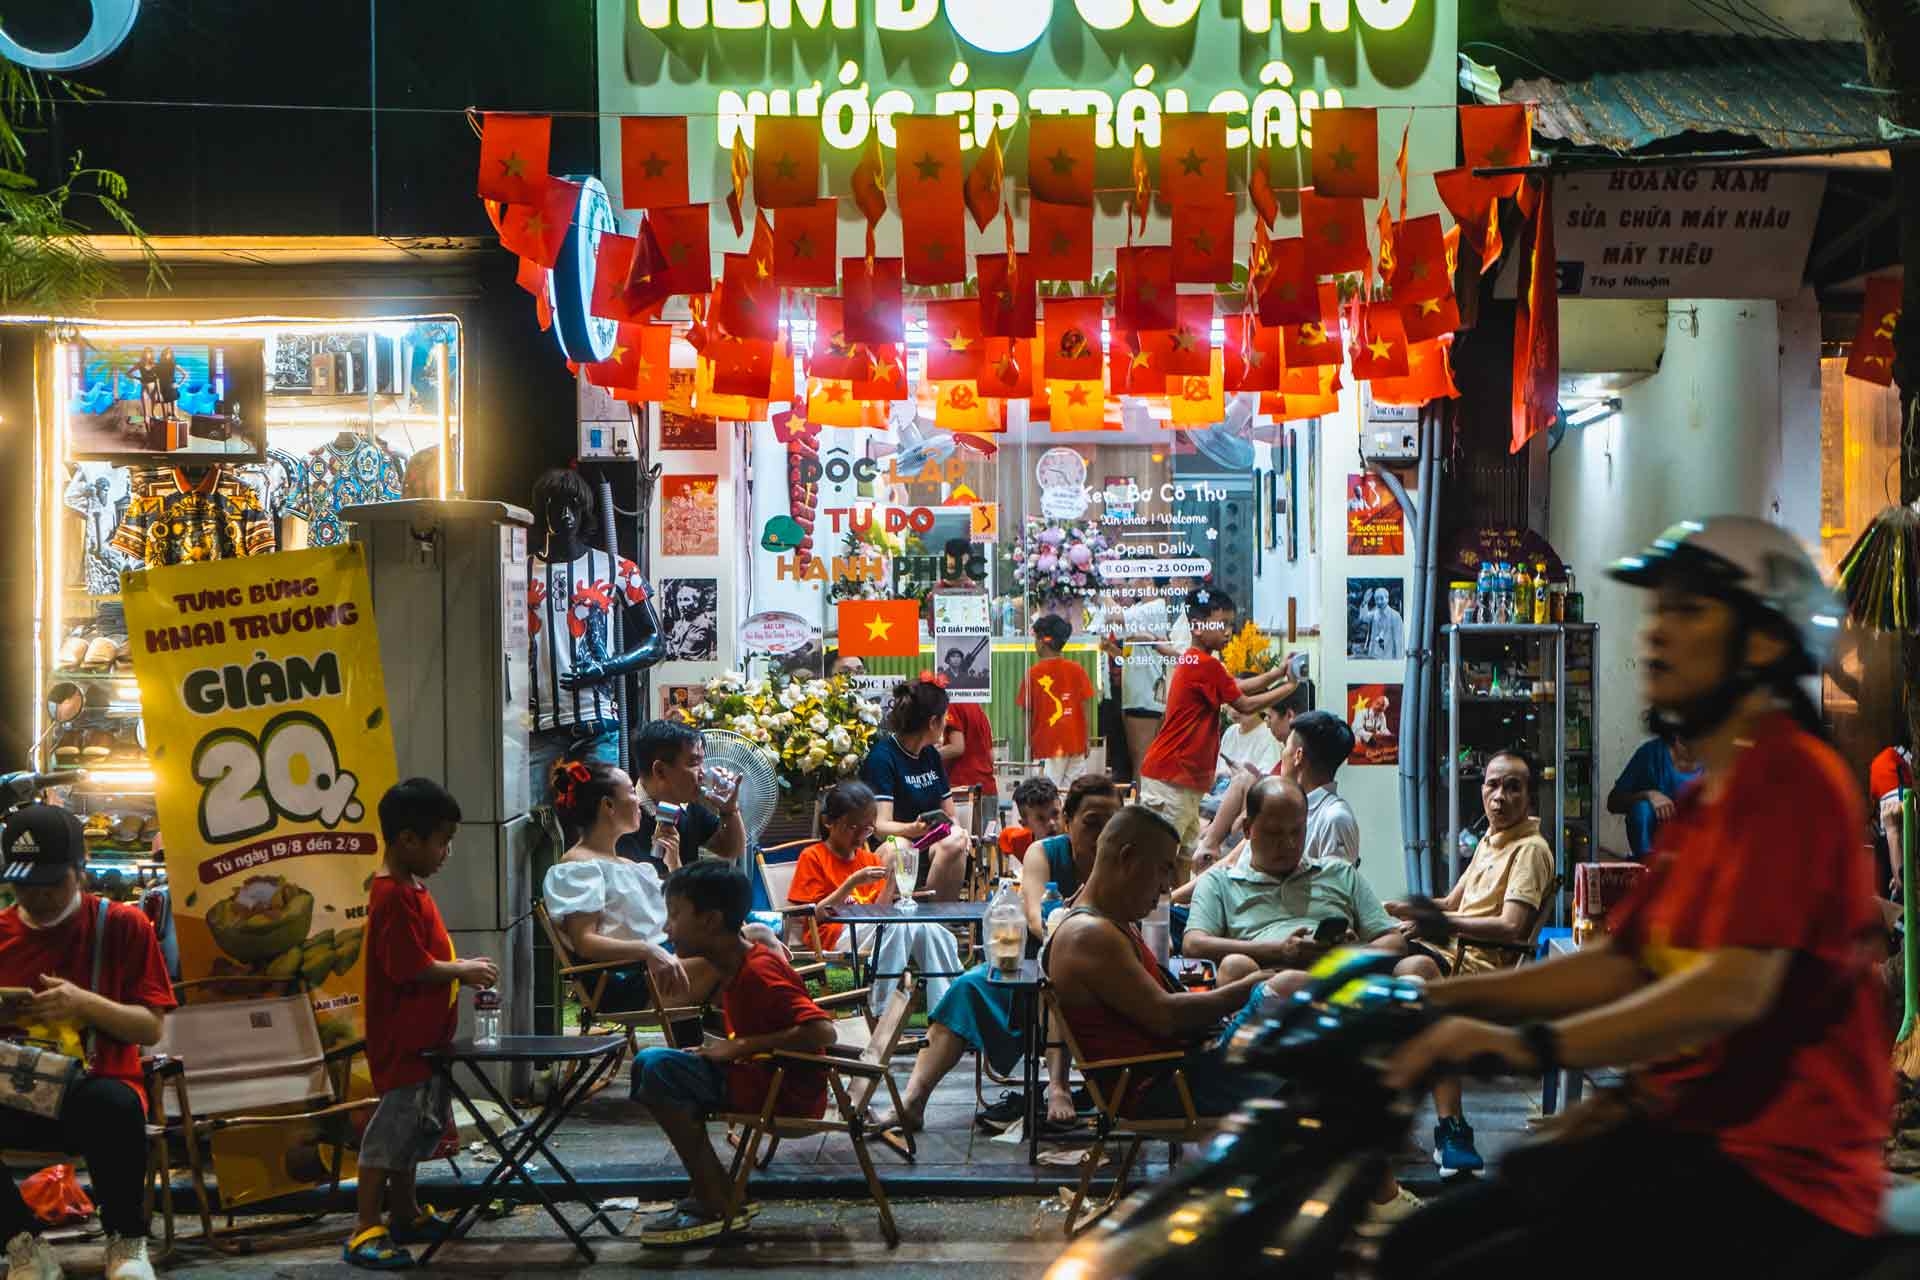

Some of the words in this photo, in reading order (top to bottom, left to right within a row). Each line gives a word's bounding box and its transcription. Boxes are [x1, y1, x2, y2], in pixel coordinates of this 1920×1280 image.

[1680, 205, 1728, 228] MÁY
[1602, 241, 1648, 265] MÁY
[1658, 241, 1714, 265] THÊU
[889, 448, 967, 493] LẬP
[1128, 483, 1153, 503] Bơ
[1160, 484, 1186, 503] Cô
[1192, 481, 1228, 502] Thu
[824, 502, 877, 543] TỰ
[885, 507, 935, 534] DO
[1100, 514, 1122, 526] Xin
[1158, 512, 1208, 526] Welcome
[1115, 543, 1155, 558] Open
[1159, 541, 1195, 556] Daily
[777, 555, 883, 591] HẠNH
[1100, 589, 1120, 598] KEM
[1122, 588, 1136, 598] BƠ
[1160, 587, 1188, 597] NGON
[145, 617, 226, 654] KHAI
[229, 602, 359, 641] TRƯƠNG
[1101, 624, 1123, 633] SINH
[1197, 621, 1225, 631] THƠM
[183, 651, 342, 714] GIẢM
[192, 711, 365, 844] 20%
[235, 849, 269, 868] ngày
[272, 840, 302, 857] 19/8
[306, 834, 332, 851] đến
[335, 838, 361, 851] 2/9
